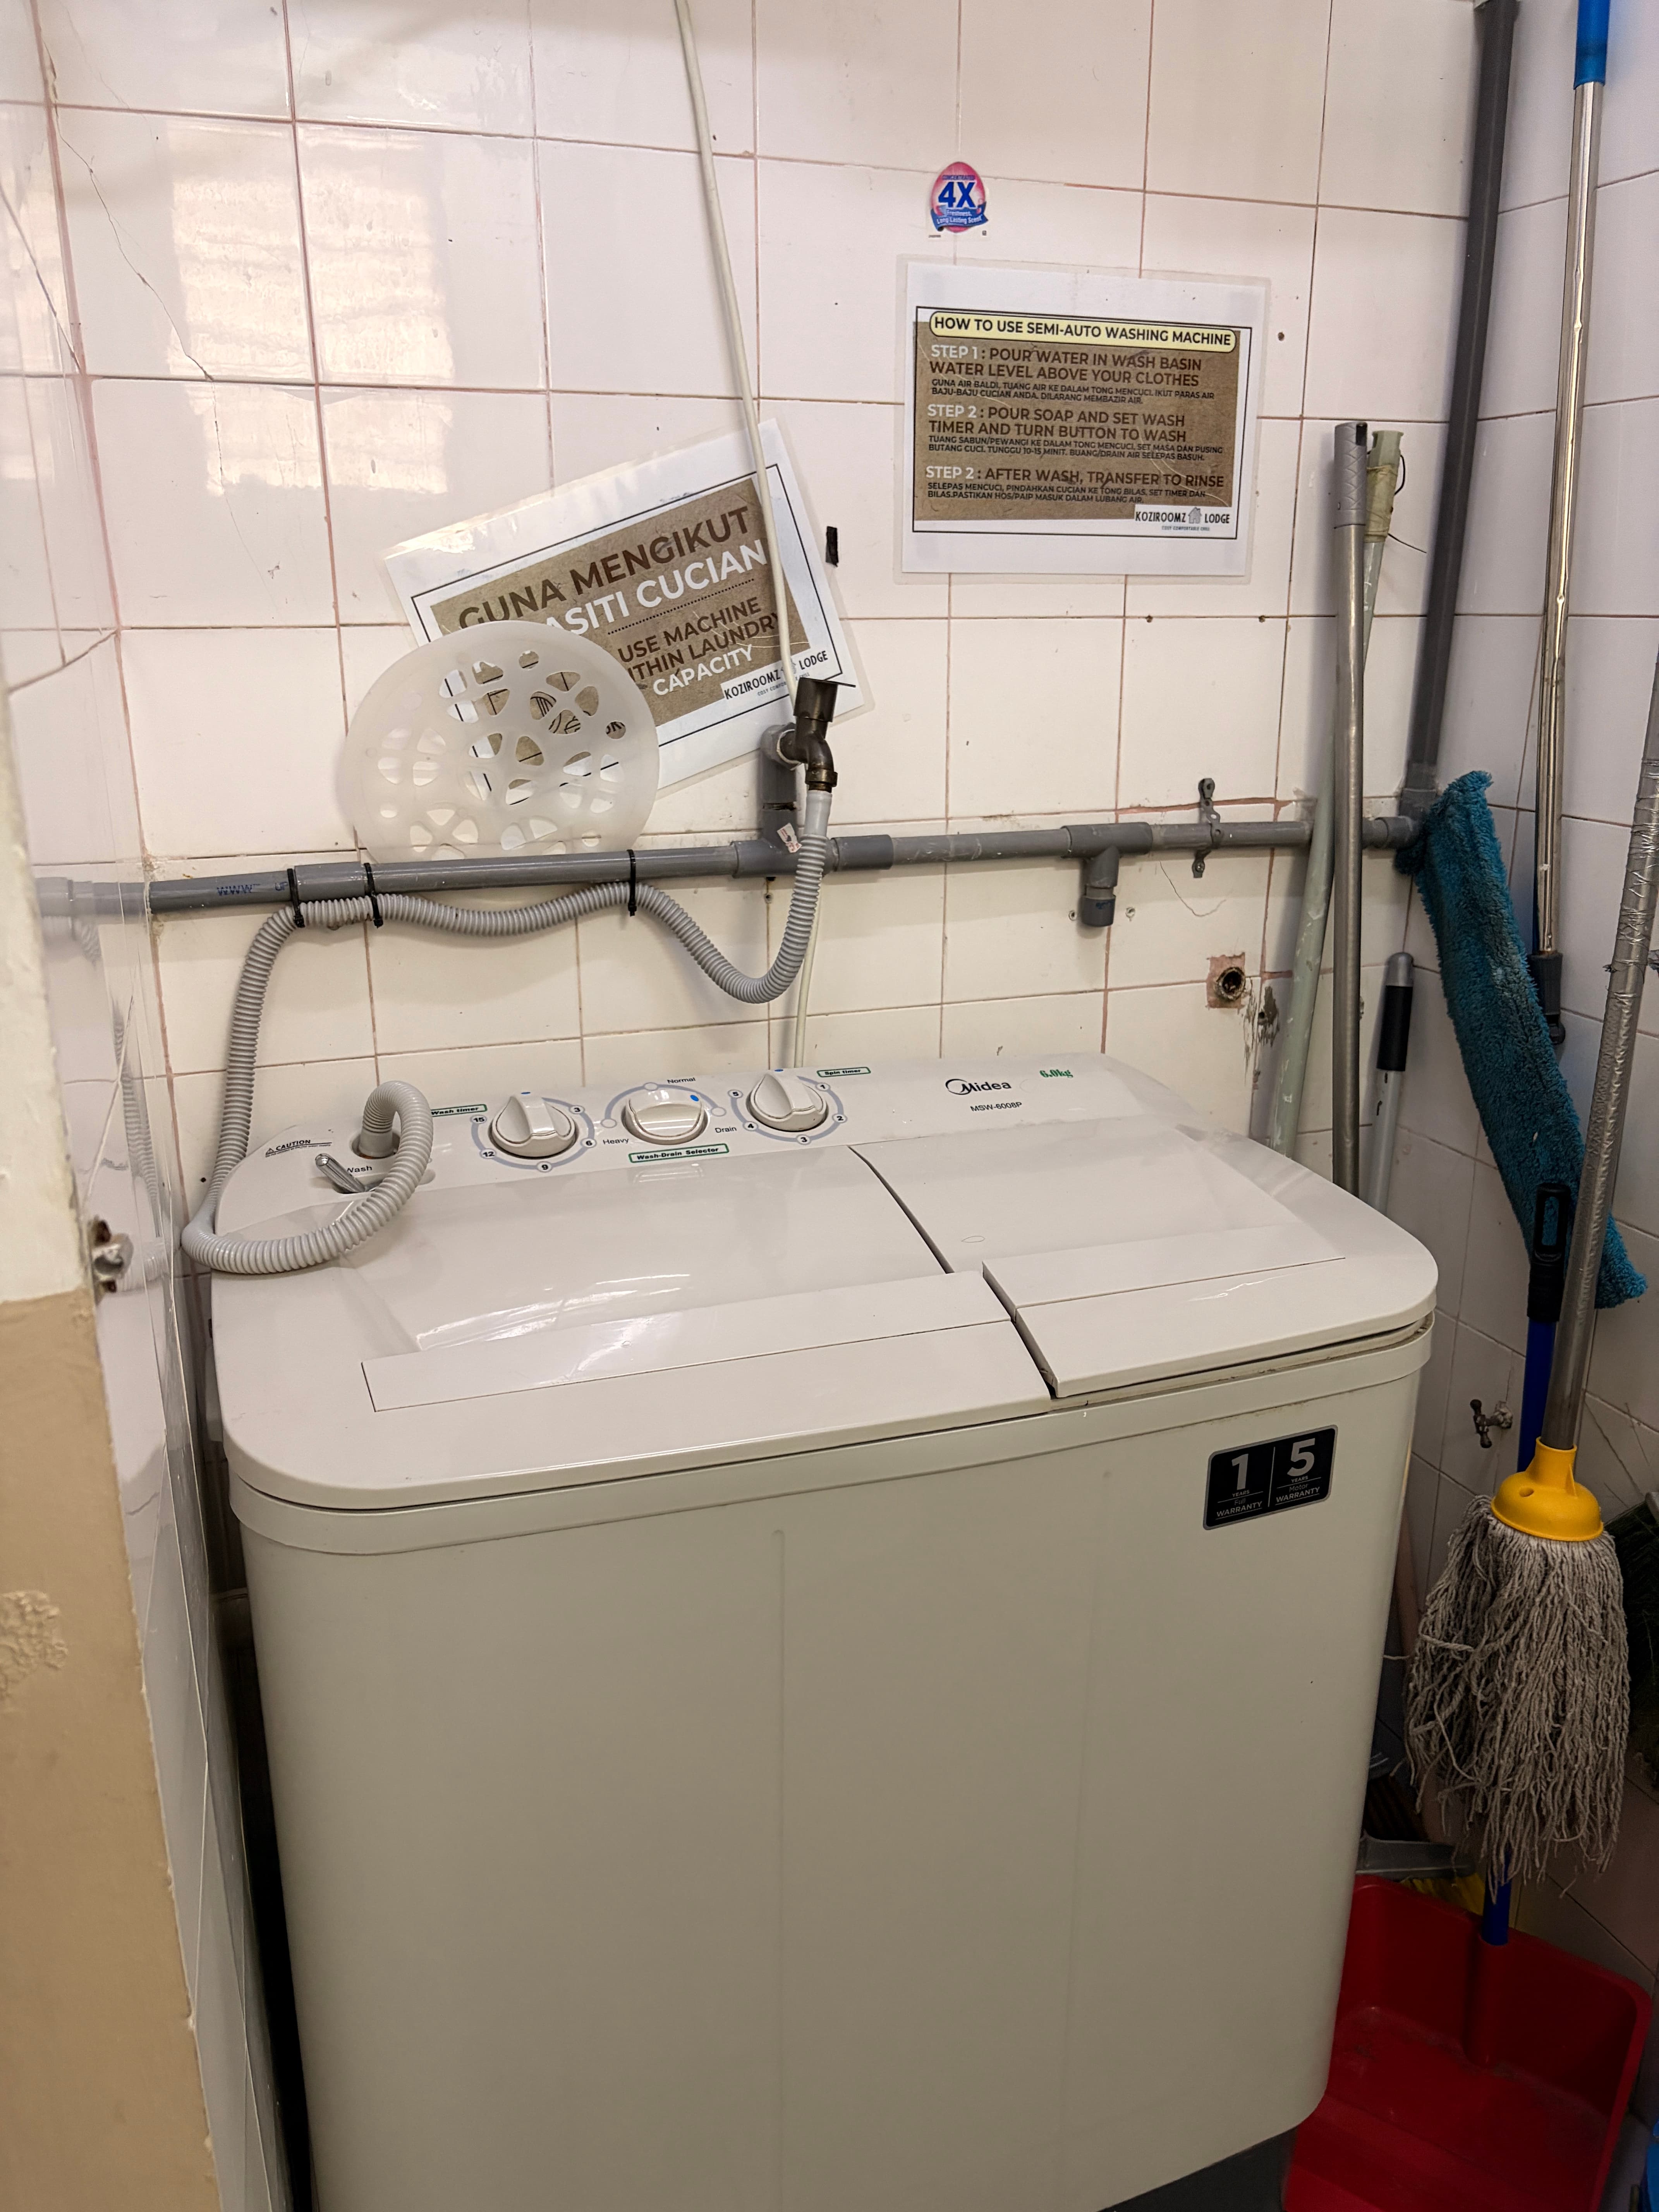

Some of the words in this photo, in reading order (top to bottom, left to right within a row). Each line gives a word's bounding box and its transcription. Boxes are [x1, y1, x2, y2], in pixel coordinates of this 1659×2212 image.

[938, 182, 976, 207] 4X
[935, 317, 970, 330] HOW
[974, 319, 992, 331] TO
[998, 321, 1023, 333] USE
[1027, 323, 1101, 337] SEMI-AUTO
[1106, 327, 1168, 341] WASHING
[1173, 331, 1231, 345] MACHINE
[931, 345, 968, 359] STEP
[972, 347, 977, 359] 1
[990, 348, 1030, 361] POUR
[1037, 351, 1088, 364] WATER
[1094, 354, 1107, 366] IN
[1113, 354, 1154, 368] WASH
[1160, 357, 1201, 371] BASIN
[930, 361, 983, 376] WATER
[989, 364, 1033, 378] LEVEL
[1037, 367, 1087, 380] ABOVE
[1092, 369, 1131, 383] YOUR
[1136, 372, 1199, 386] CLOTHES
[932, 379, 955, 387] GUNA
[1175, 390, 1200, 399] PARAS
[932, 387, 978, 397] BAJU-BAJU
[980, 390, 1011, 398] CUCIAN
[1041, 393, 1082, 401] DILARANG
[1084, 395, 1126, 403] MEMBAZIR
[927, 404, 964, 417] STEP
[968, 405, 977, 418] 2
[989, 407, 1029, 420] POUR
[1034, 409, 1073, 422] SOAP
[1077, 411, 1108, 423] AND
[1113, 412, 1138, 424] SET
[1142, 413, 1185, 426] WASH
[929, 420, 974, 434] TIMER
[978, 422, 1010, 435] AND
[1015, 424, 1053, 437] TURN
[1060, 426, 1116, 439] BUTTON
[1121, 428, 1139, 440] TO
[1144, 429, 1186, 442] WASH
[959, 436, 1028, 446] SABUN/PEWANGI
[1195, 446, 1223, 454] PUSING
[988, 446, 1021, 455] TUNGGU
[1070, 449, 1125, 457] BUANG/DRAIN
[926, 465, 962, 479] STEP
[965, 467, 974, 479] 2
[985, 468, 1031, 481] AFTER
[1036, 469, 1083, 484] WASH,
[1087, 471, 1159, 485] TRANSFER
[1163, 474, 1181, 486] TO
[1186, 475, 1224, 487] RINSE
[995, 492, 1033, 500] HOS/PAIP
[1006, 484, 1054, 493] PINDAHKAN
[1135, 512, 1186, 522] KOZIROOMZ
[1205, 514, 1230, 524] LODGE
[459, 579, 567, 629] GUNA
[570, 506, 748, 595] MENGIKUT
[637, 539, 767, 608] CUCIAN
[618, 635, 660, 662] USE
[663, 597, 761, 646] MACHINE
[627, 649, 684, 682] ITHIN
[653, 644, 752, 695] CAPACITY
[724, 670, 781, 699] KOZIROOMZ
[799, 651, 828, 670] LODGE
[1039, 1069, 1073, 1078] 6.0kg
[953, 1080, 1012, 1095] Midea
[970, 1102, 1022, 1112] MSW-6008P
[276, 1140, 311, 1150] CAUTION
[637, 1152, 682, 1160] Wash-Drain
[1287, 1438, 1316, 1477] 5
[1231, 1453, 1249, 1491] 1
[1276, 1487, 1320, 1502] WARRANTY
[1289, 1484, 1308, 1492] Motor
[1217, 1501, 1262, 1517] WARRANTY
